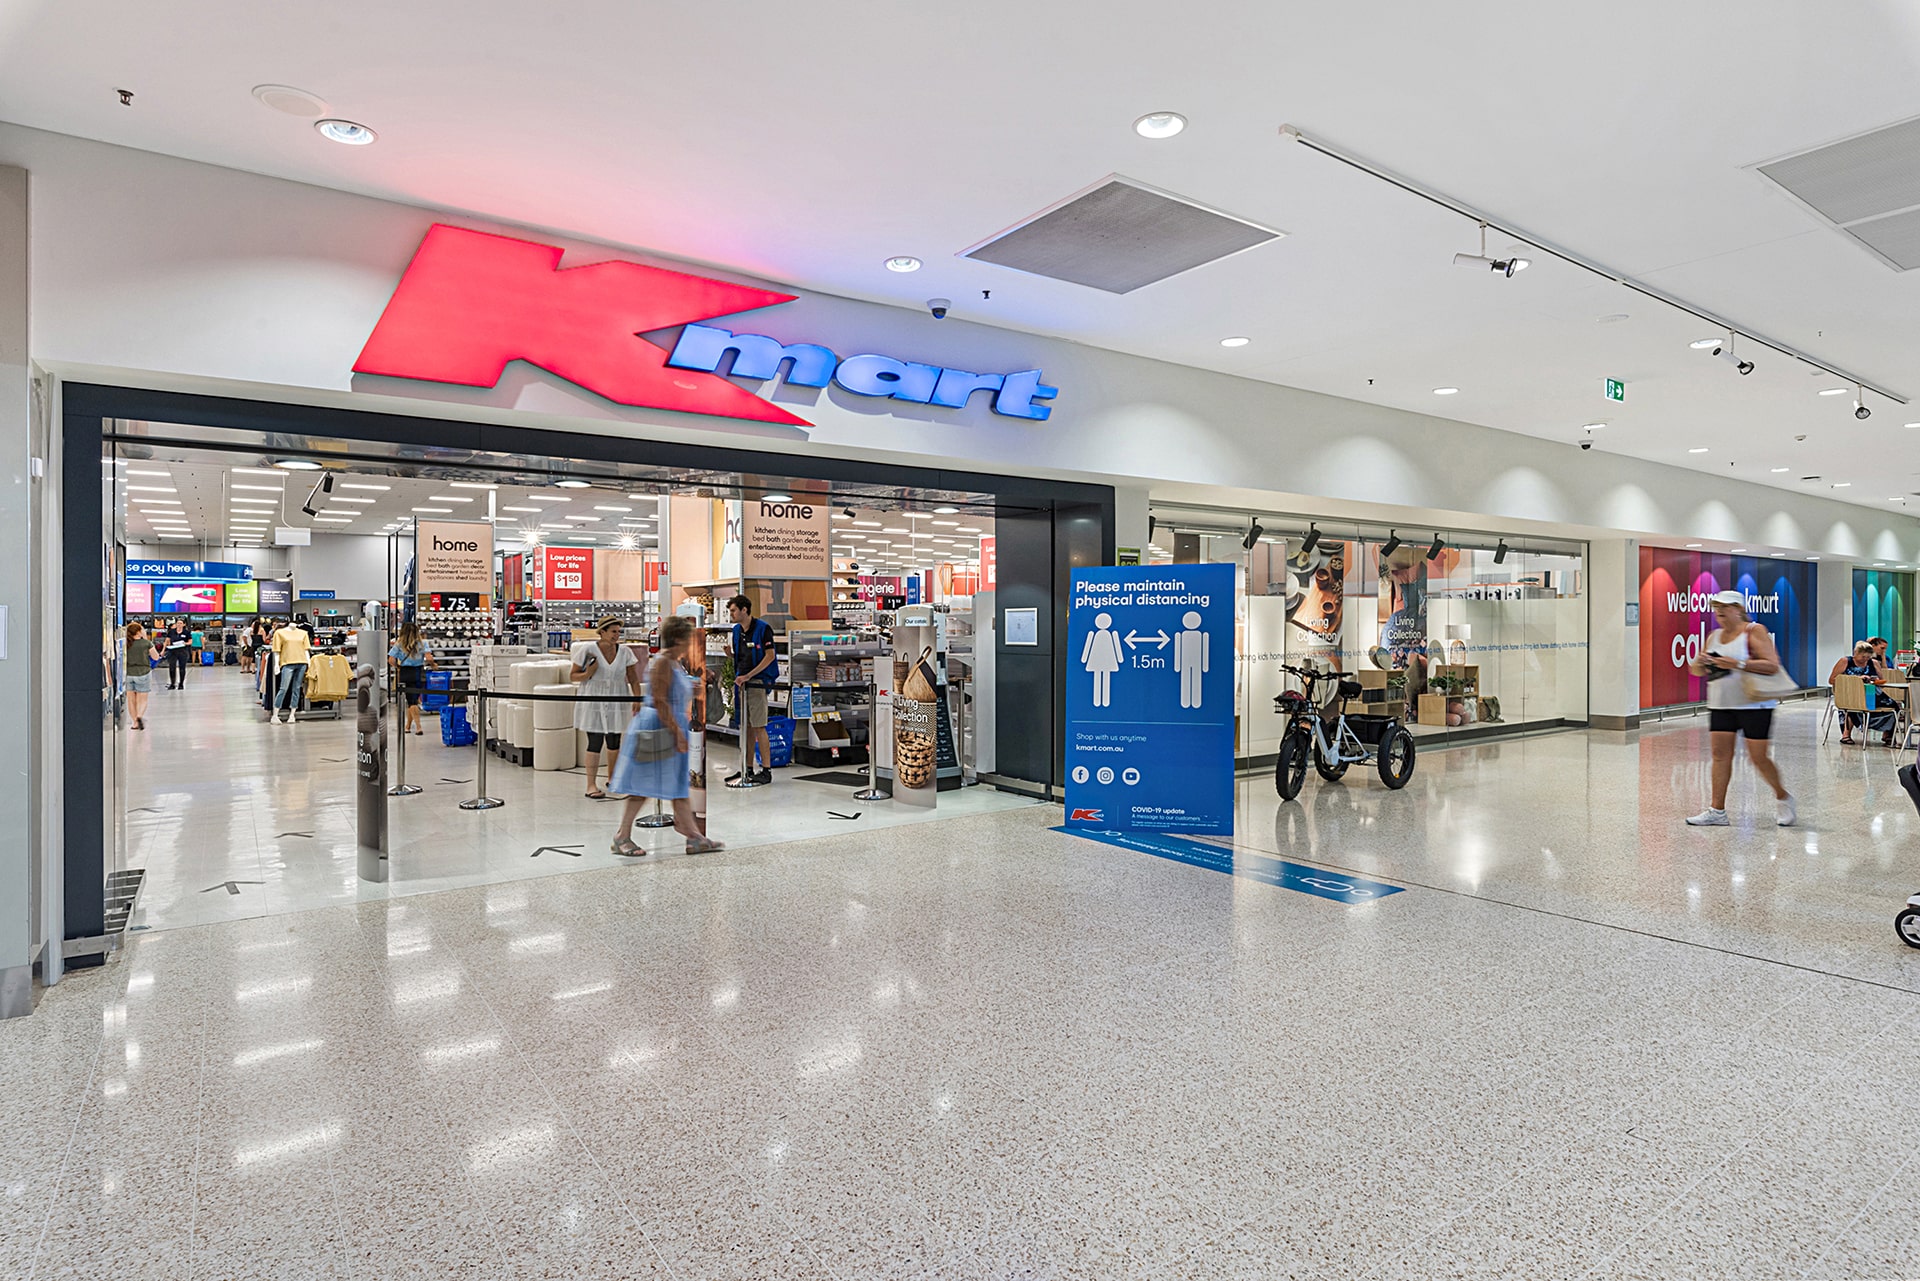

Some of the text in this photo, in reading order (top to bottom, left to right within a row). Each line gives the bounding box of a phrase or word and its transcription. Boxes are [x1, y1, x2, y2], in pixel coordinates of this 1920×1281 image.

[761, 502, 813, 519] home
[777, 528, 796, 537] dining
[796, 528, 818, 538] storage
[433, 535, 478, 552] home
[782, 537, 804, 545] garden
[753, 552, 786, 560] appliances
[802, 553, 824, 562] laundry
[142, 563, 164, 574] pay
[168, 562, 191, 573] here
[1076, 579, 1184, 592] Please maintain
[1075, 592, 1210, 609] physical distancing
[1667, 585, 1779, 614] welcom kmart
[1305, 616, 1328, 628] Living
[1395, 616, 1414, 628] Living
[1297, 630, 1336, 642] Collection
[1388, 629, 1422, 640] Collection
[1132, 655, 1164, 668] 1.5m
[1076, 732, 1094, 740] Shop
[1119, 734, 1146, 742] anytime
[1076, 744, 1124, 752] kmart.com.au
